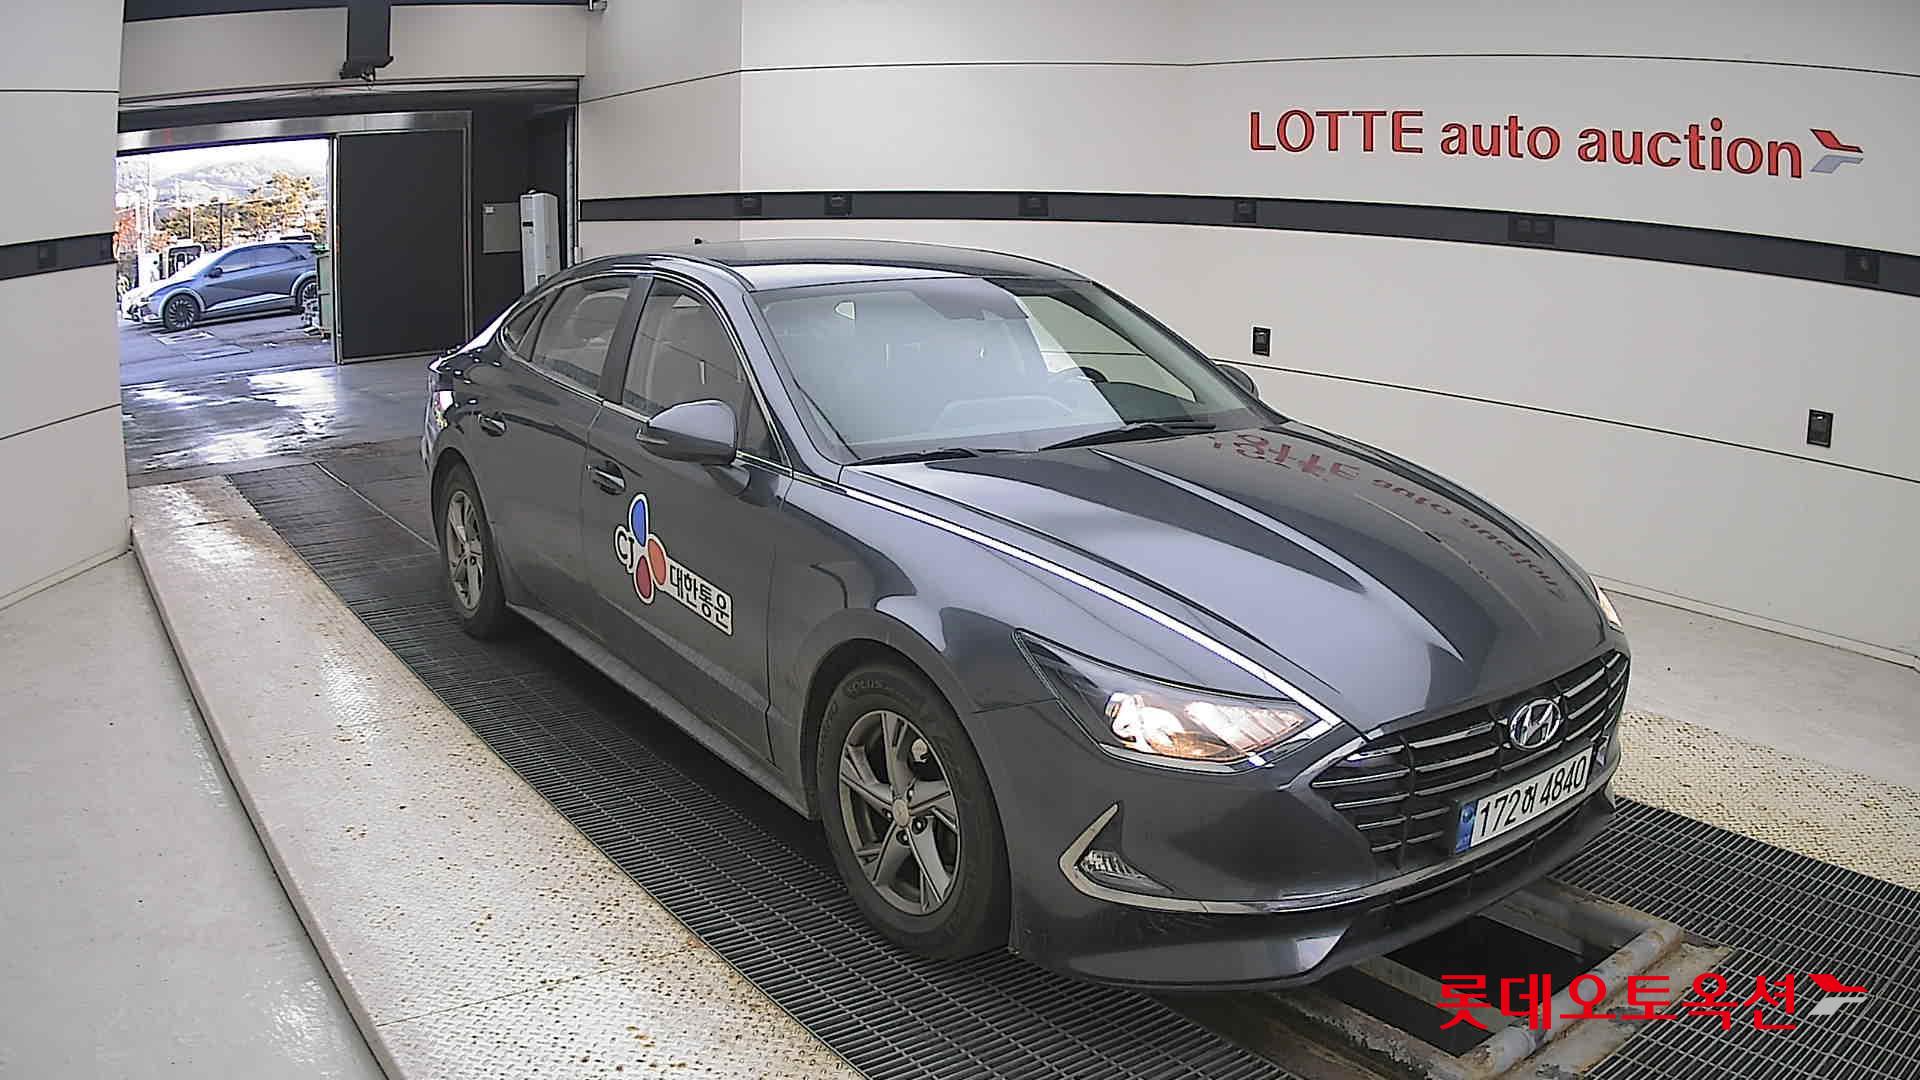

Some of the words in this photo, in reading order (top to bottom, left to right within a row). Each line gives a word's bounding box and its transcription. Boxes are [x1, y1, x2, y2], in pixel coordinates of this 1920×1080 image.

[1249, 110, 1424, 154] LOTTE
[1440, 115, 1560, 160] auto
[1576, 118, 1803, 179] auction
[617, 530, 635, 569] CJ
[669, 564, 731, 629] 대한통운
[1481, 782, 1538, 837] 172허
[1540, 755, 1587, 805] 4840
